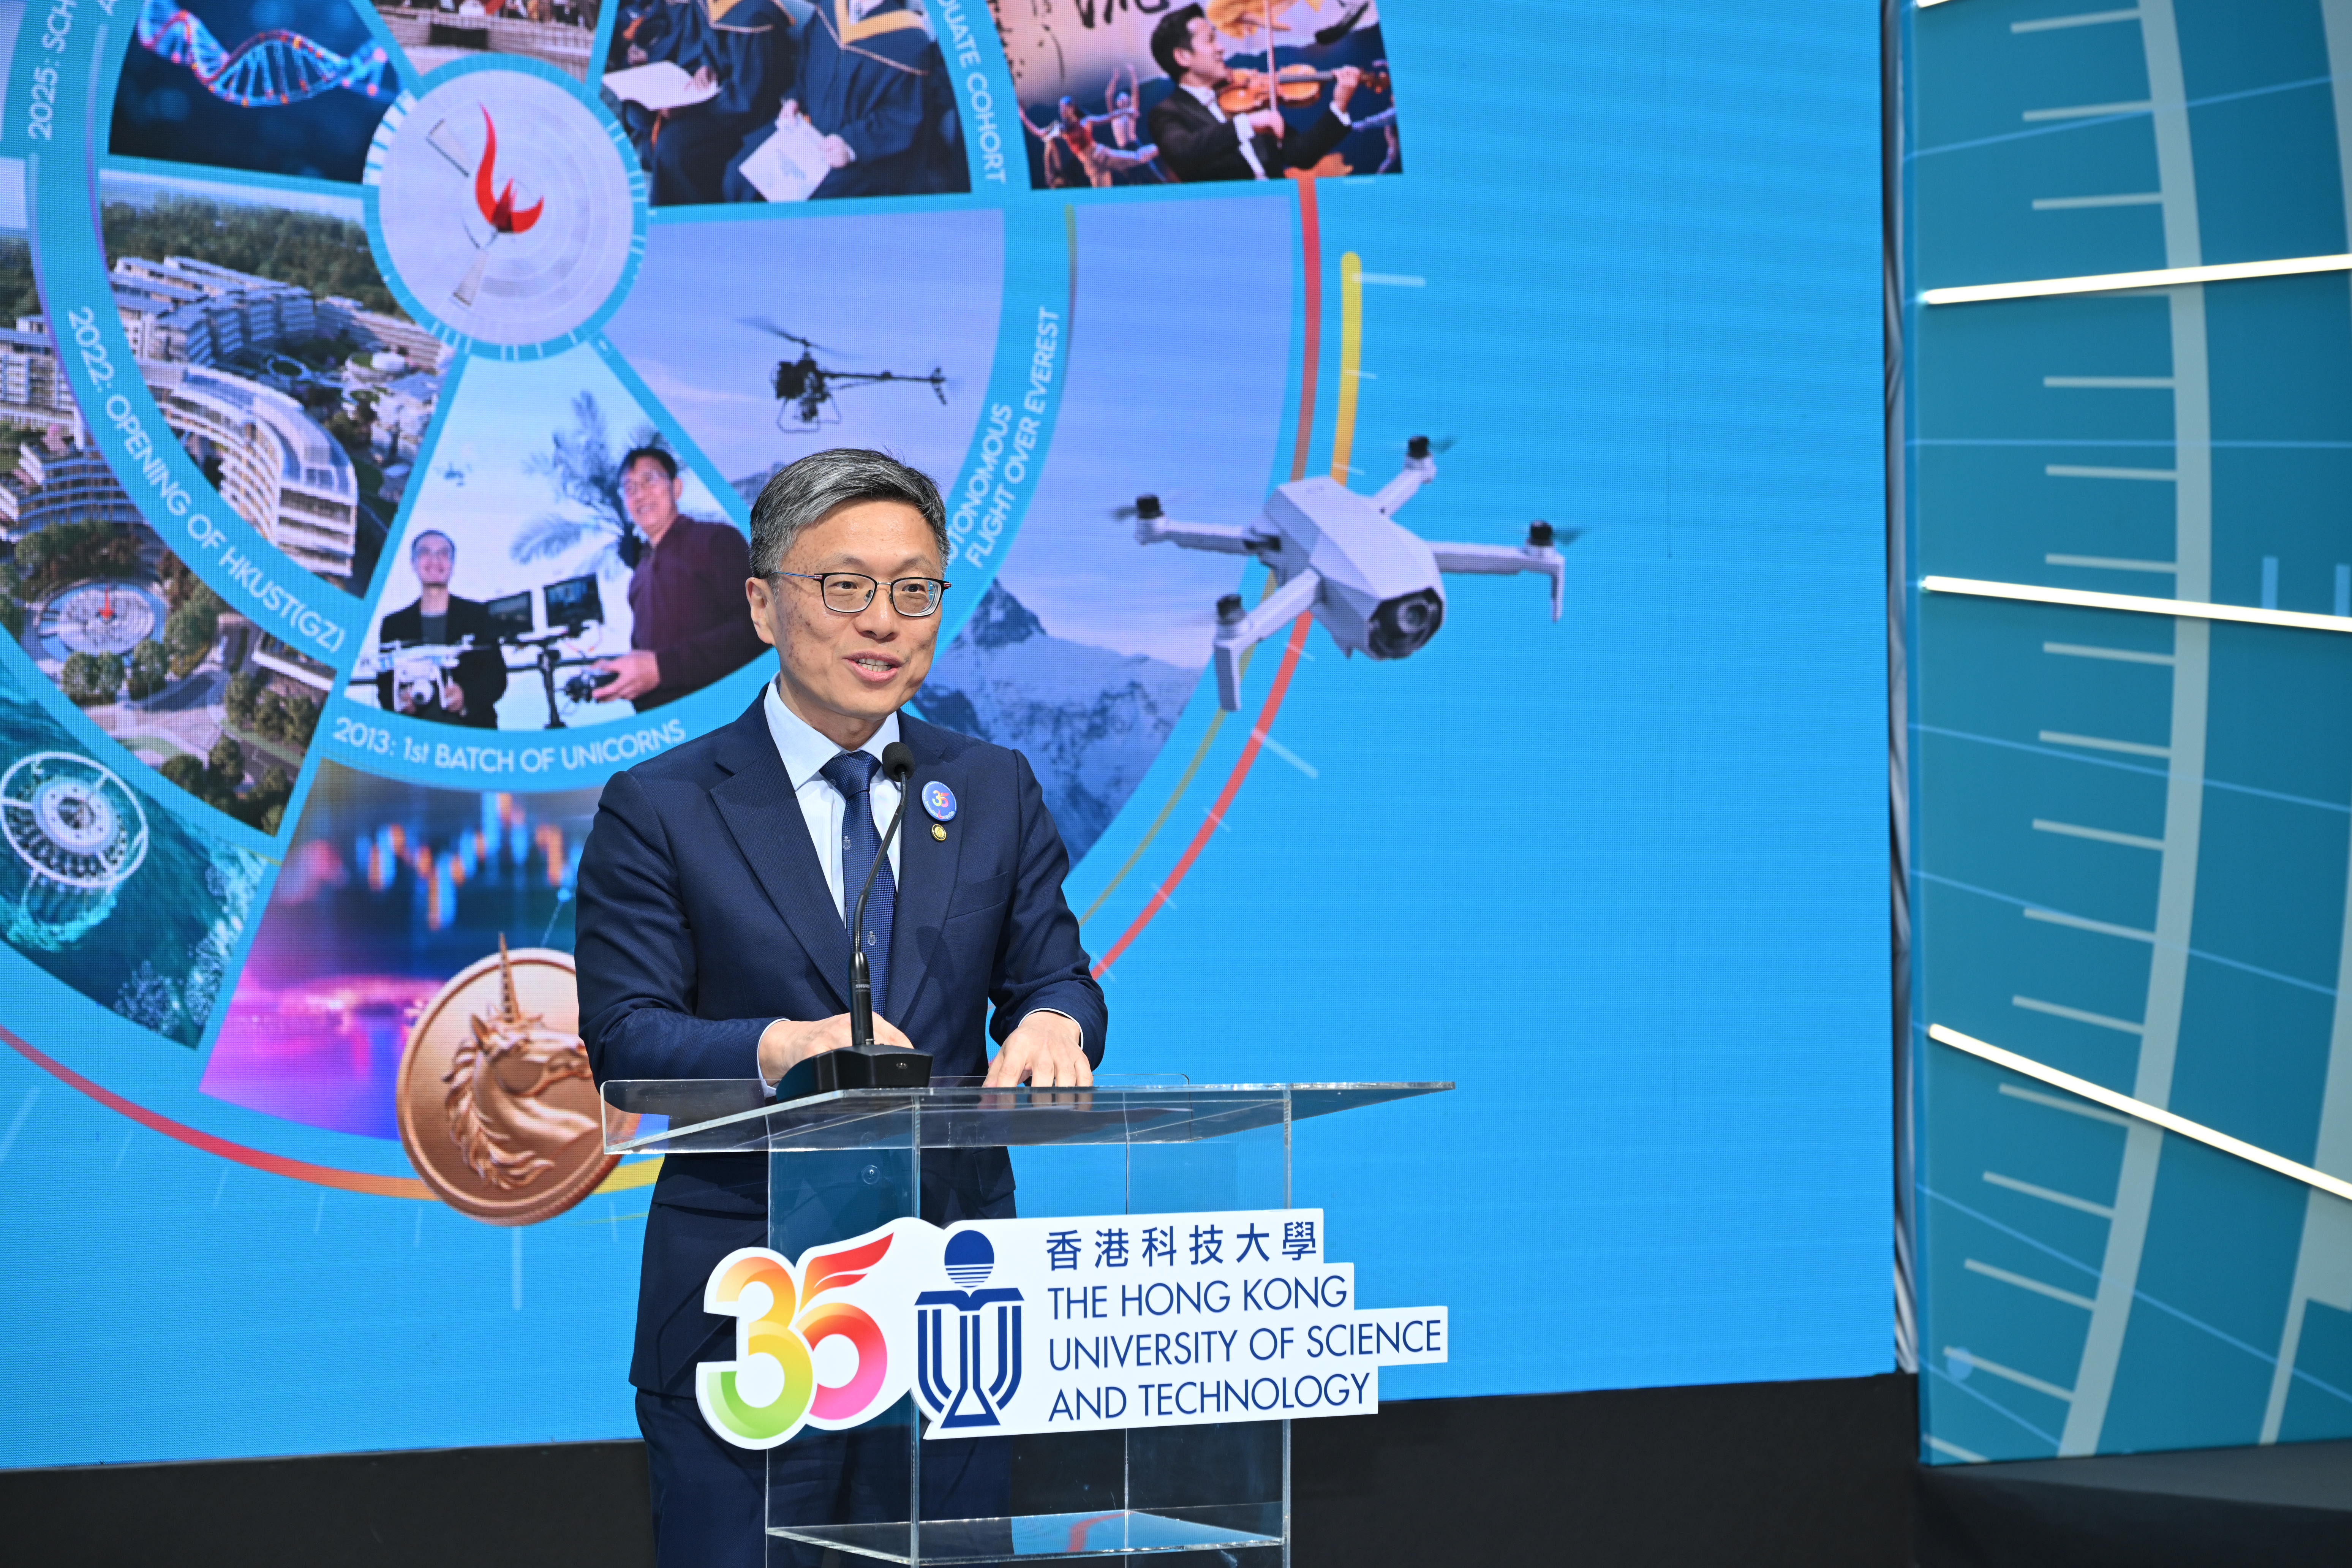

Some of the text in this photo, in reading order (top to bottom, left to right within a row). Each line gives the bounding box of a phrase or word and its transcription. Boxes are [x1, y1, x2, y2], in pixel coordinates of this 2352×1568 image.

[28, 58, 60, 140] 2025:
[967, 72, 1006, 185] COHORT
[965, 306, 1059, 567] FLIGHT OVER EVEREST
[68, 306, 346, 652] 2022: OPENING OF HKUST(GZ)
[332, 717, 686, 773] 2013: 1st BATCH OF UNICORNS
[932, 790, 949, 808] 35
[1046, 1221, 1316, 1271] 香港科技大學
[1047, 1275, 1347, 1320] THE HONG KONG
[707, 1232, 894, 1439] 35
[1050, 1320, 1441, 1371] UNIVERSITY OF SCIENCE
[1049, 1373, 1370, 1421] AND TECHNOLOGY
